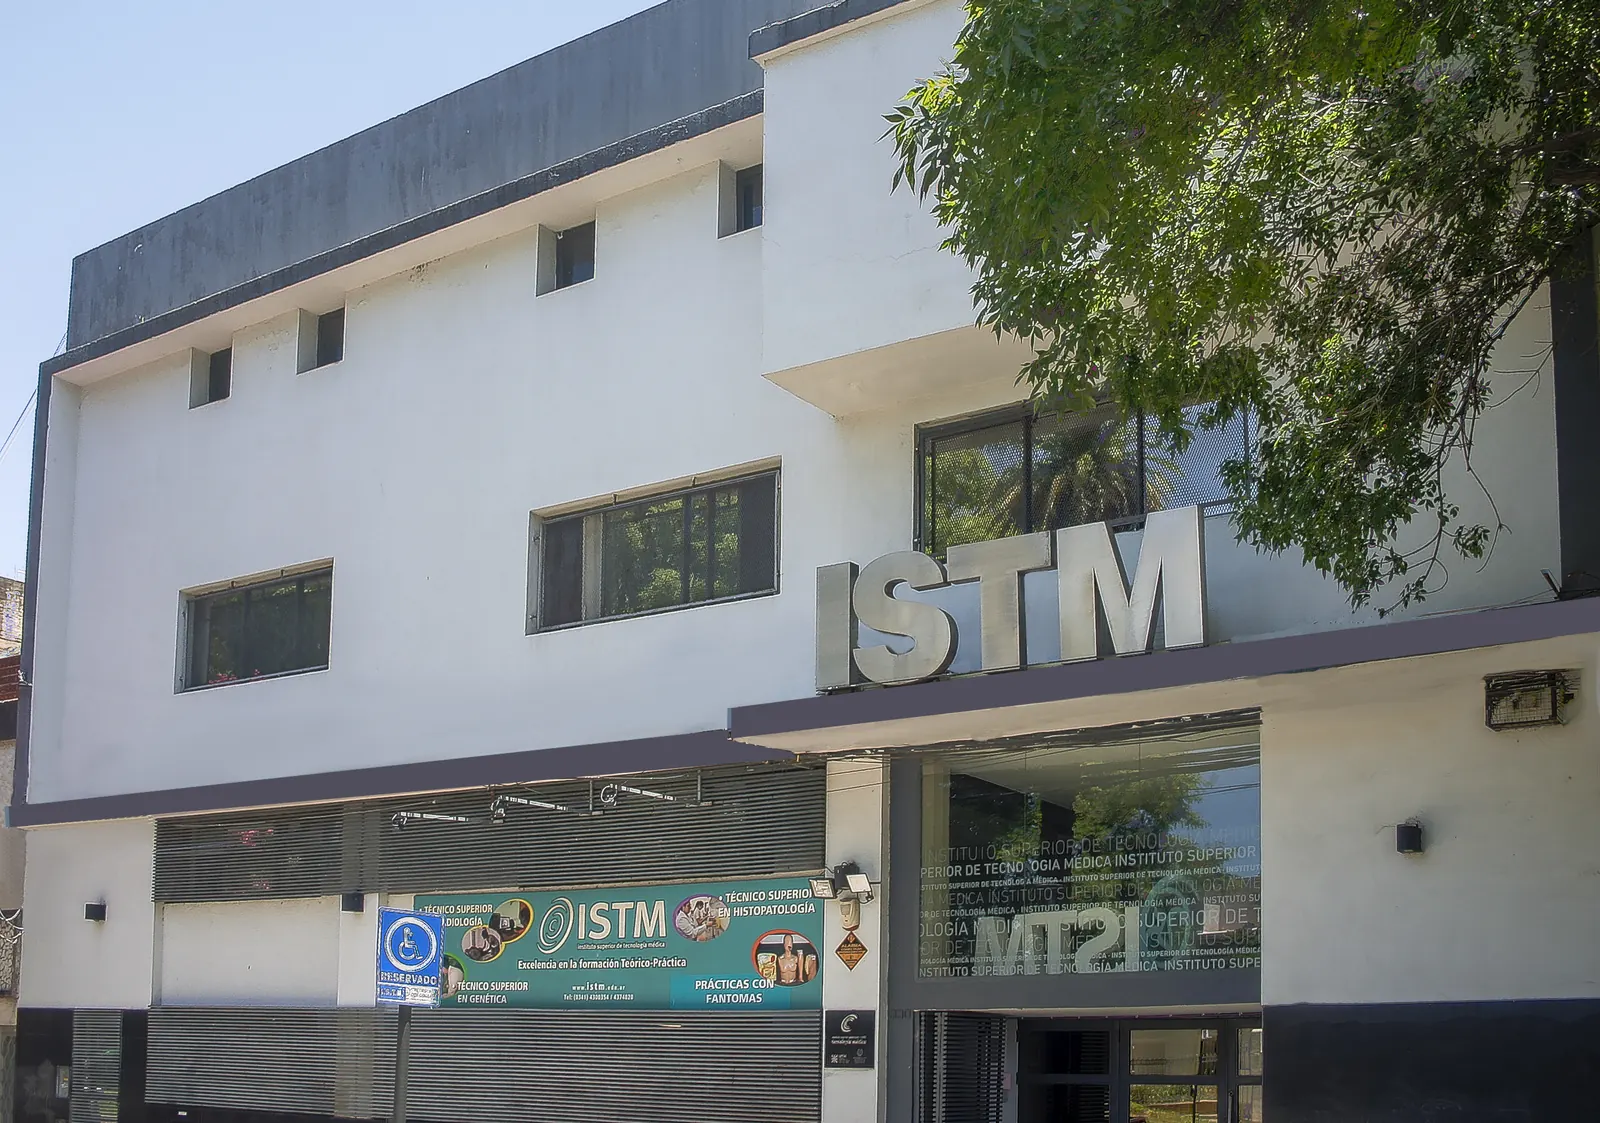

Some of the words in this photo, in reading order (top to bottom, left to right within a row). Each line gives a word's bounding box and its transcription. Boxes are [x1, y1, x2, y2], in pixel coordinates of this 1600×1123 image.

[816, 505, 1206, 690] ISTM
[1081, 837, 1101, 854] DE
[965, 863, 981, 876] DE
[1115, 850, 1183, 868] INSTITUTO
[1187, 845, 1257, 863] SUPERIOR
[948, 880, 980, 890] SUPERIOR
[981, 879, 990, 888] DE
[1063, 873, 1098, 884] INSTITUTO
[1100, 871, 1135, 881] SUPERIOR
[1136, 871, 1146, 880] DE
[725, 891, 766, 903] TÉCNICO
[1057, 882, 1123, 901] SUPERIOR
[424, 904, 455, 914] TÉCNICO
[456, 903, 493, 913] SUPERIOR
[718, 906, 731, 917] EN
[733, 903, 815, 917] HISTOPATOLOGÍA
[931, 908, 940, 918] DE
[1021, 903, 1060, 914] INSTITUTO
[1203, 893, 1247, 905] INSTITUTO
[576, 900, 667, 940] ISTM
[1225, 907, 1248, 924] DE
[945, 939, 962, 955] DE
[1147, 948, 1180, 958] SUPERIOR
[1181, 947, 1190, 957] DE
[1191, 944, 1234, 956] TECNOLOGÍA
[517, 957, 557, 970] Excelencia
[558, 960, 568, 969] en
[569, 957, 577, 969] la
[579, 957, 619, 969] formación
[621, 955, 687, 969] Teórico-Práctica
[1164, 957, 1226, 972] INSTITUTO
[380, 971, 437, 985] RESERVADO
[695, 978, 750, 990] PRÁCTICAS
[751, 978, 774, 989] CON
[457, 982, 489, 991] TÉCNICO
[491, 981, 528, 991] SUPERIOR
[457, 995, 470, 1004] EN
[471, 993, 507, 1004] GENÉTICA
[706, 993, 763, 1004] FANTOMAS
